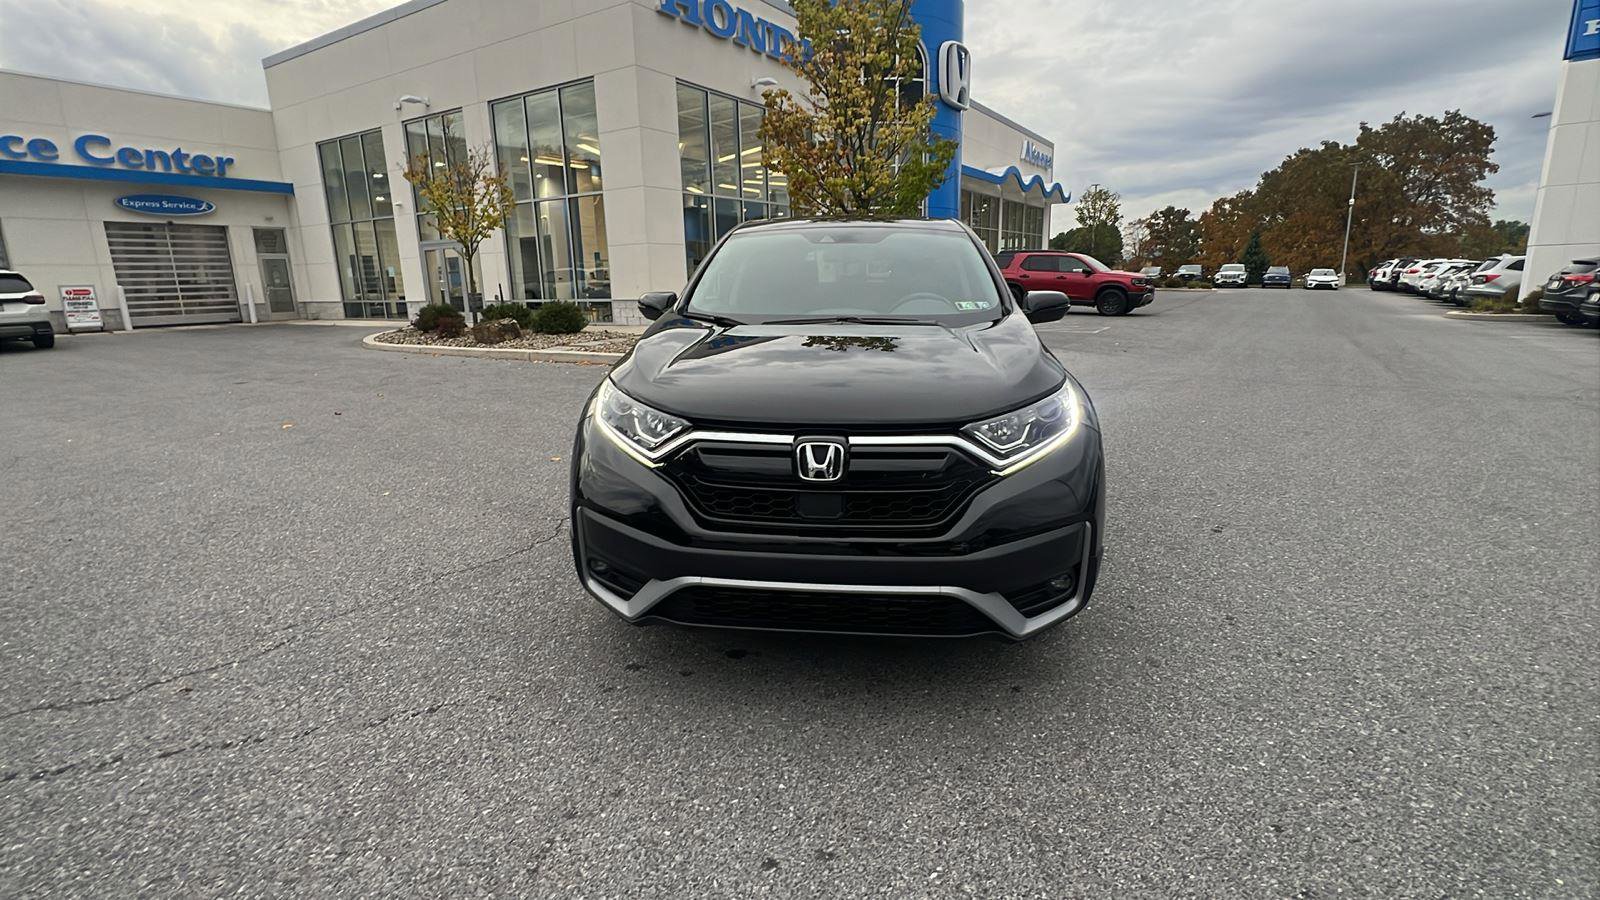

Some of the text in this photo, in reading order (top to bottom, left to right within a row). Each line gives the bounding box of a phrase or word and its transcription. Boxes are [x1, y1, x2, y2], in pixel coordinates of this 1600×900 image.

[74, 134, 234, 176] Center
[122, 198, 196, 209] Express Service
